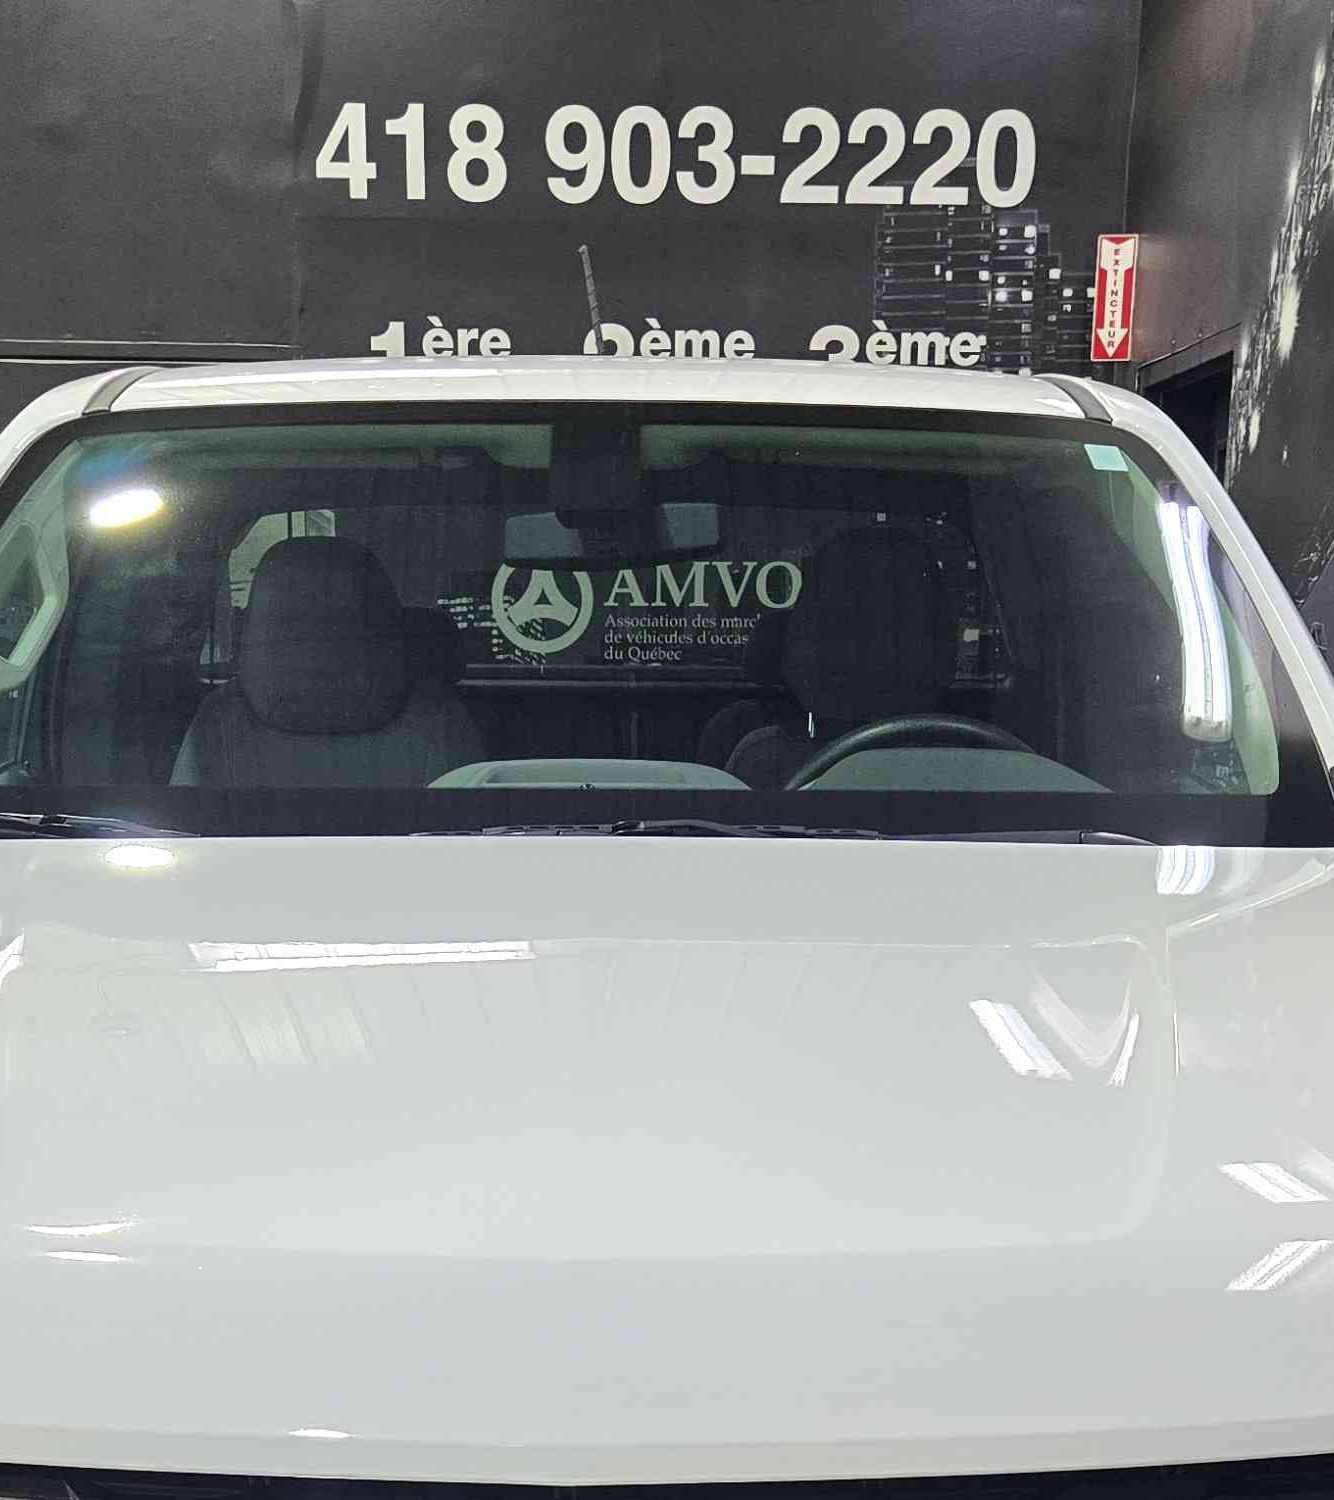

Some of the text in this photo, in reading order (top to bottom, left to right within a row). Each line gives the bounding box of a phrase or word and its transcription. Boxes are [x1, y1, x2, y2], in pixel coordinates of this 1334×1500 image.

[315, 102, 1037, 208] 418 903-2220
[1107, 248, 1121, 349] EXTINCTEUR
[603, 560, 803, 609] AMVO
[604, 612, 762, 628] Association des marc
[604, 630, 623, 644] de
[626, 629, 693, 644] véhicules
[604, 646, 683, 663] du Québec
